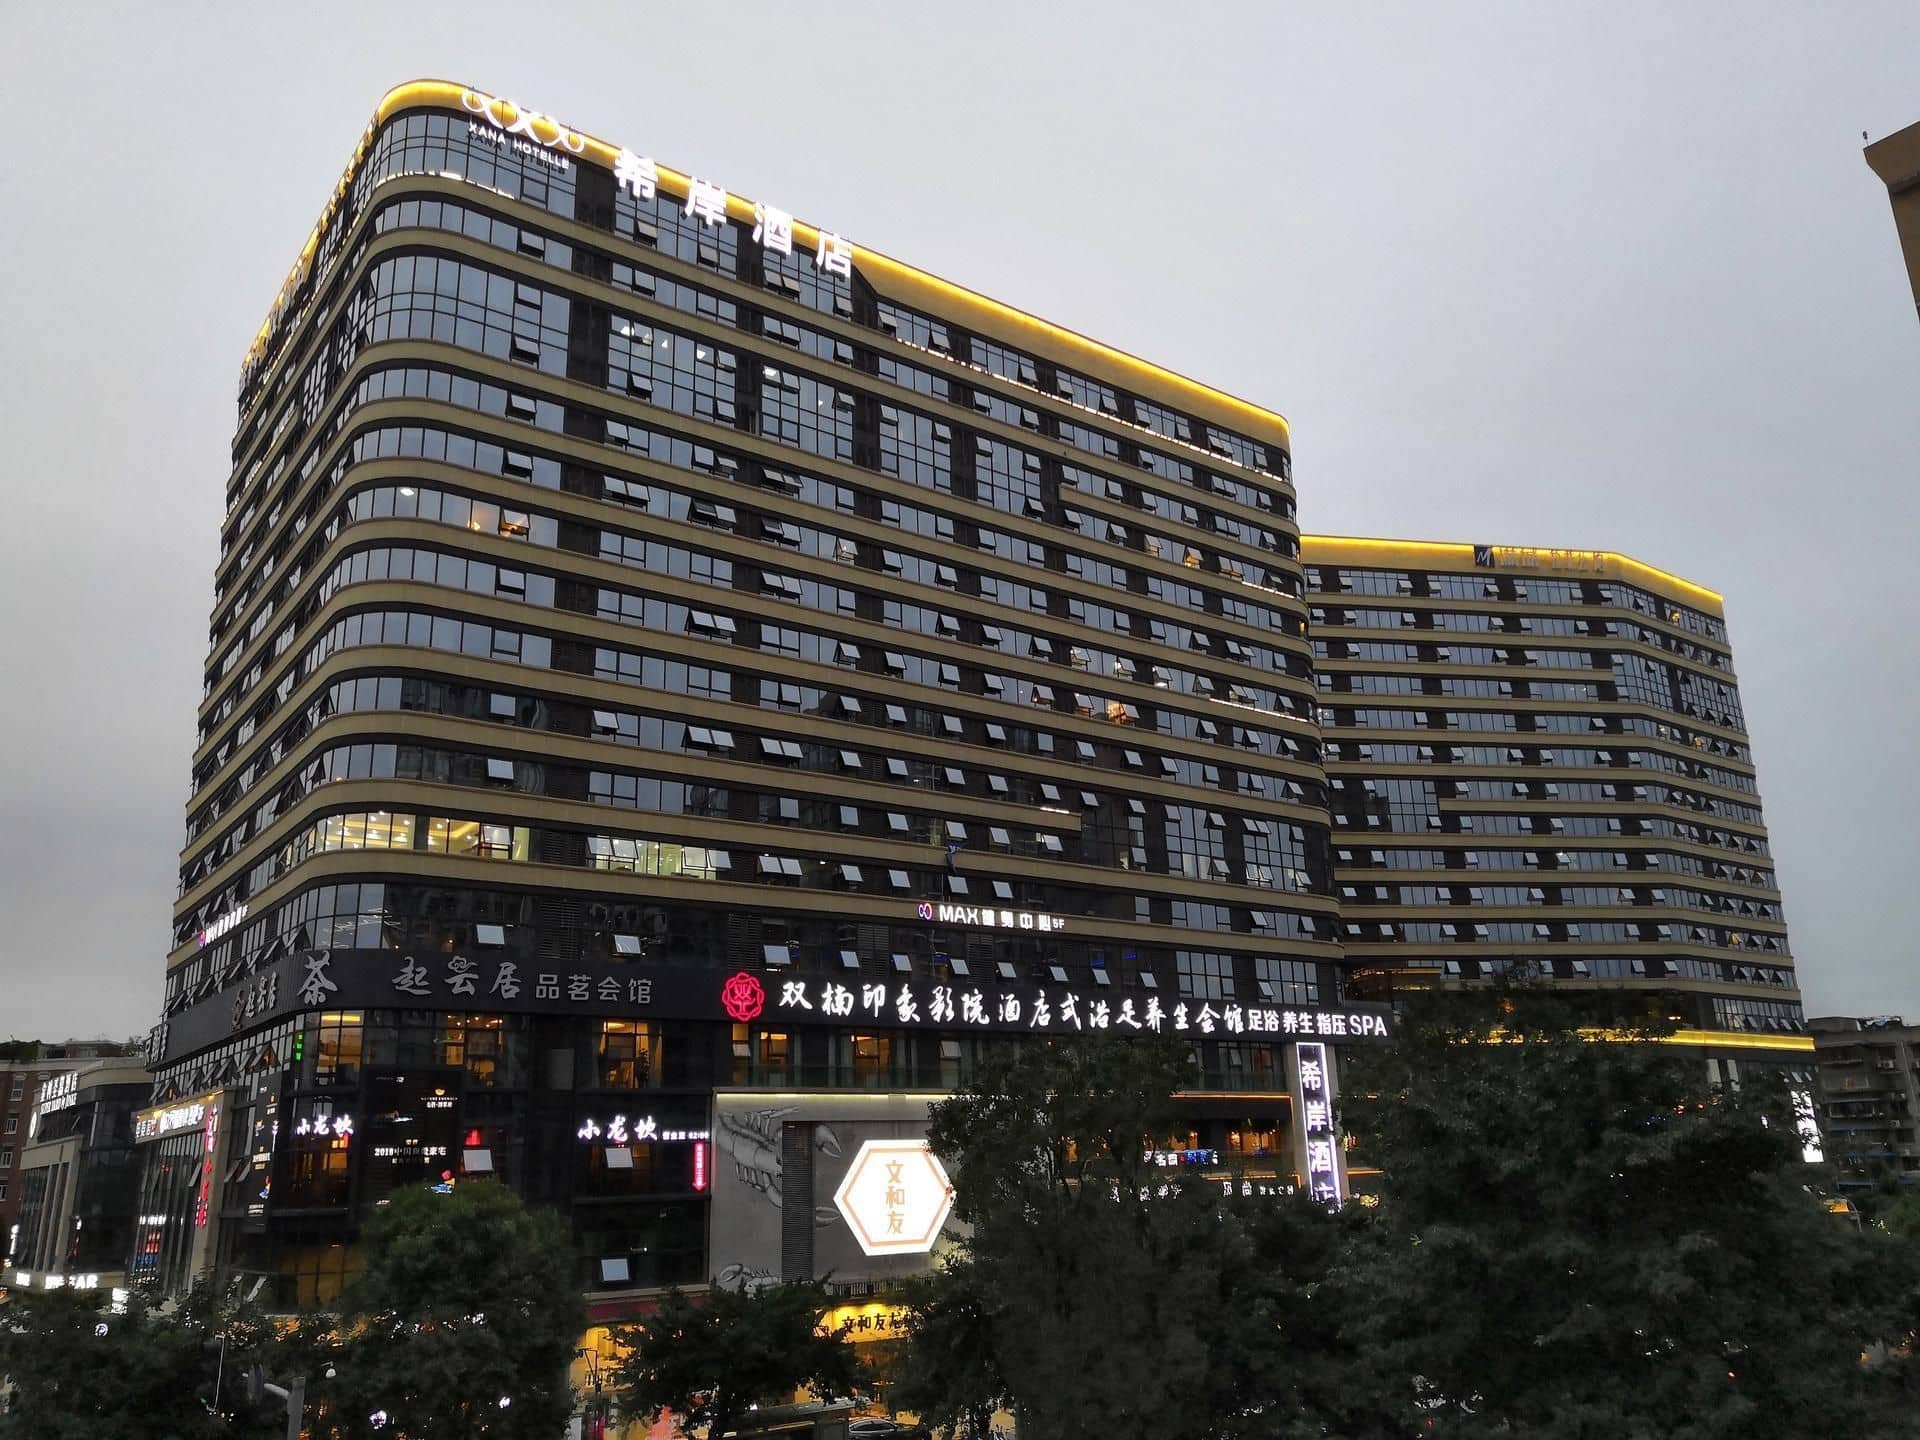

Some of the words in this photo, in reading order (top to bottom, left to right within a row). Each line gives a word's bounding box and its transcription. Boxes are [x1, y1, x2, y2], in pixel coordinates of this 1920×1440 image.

[469, 119, 506, 145] XANA
[513, 136, 570, 170] HOTELLE
[613, 146, 852, 279] 希岸酒店
[577, 1115, 658, 1142] 小龙坎
[884, 1159, 905, 1234] 文和友
